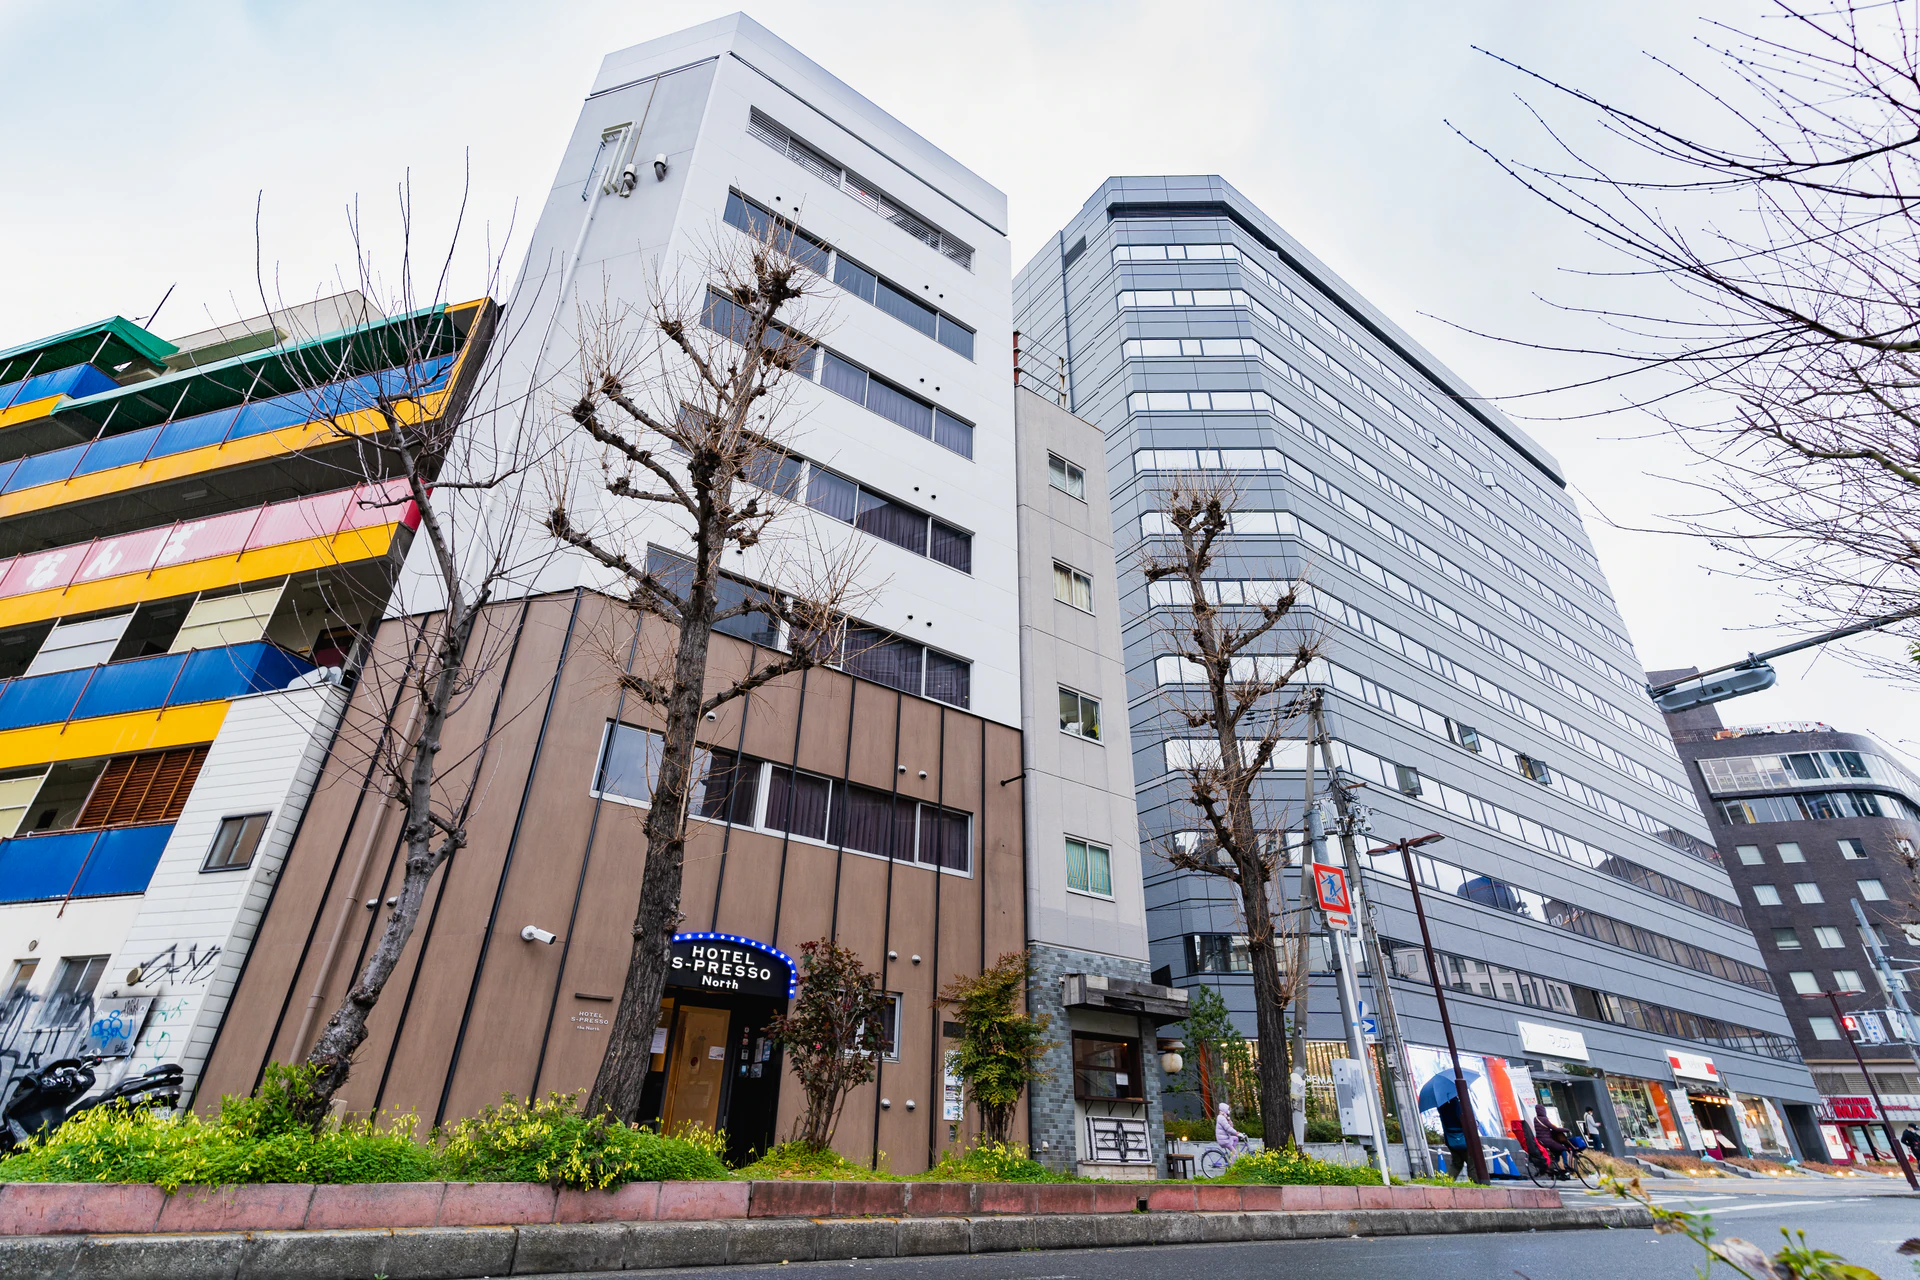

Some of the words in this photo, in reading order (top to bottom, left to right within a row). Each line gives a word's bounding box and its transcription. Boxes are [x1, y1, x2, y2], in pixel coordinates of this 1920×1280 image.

[0, 521, 206, 588] なんば
[692, 946, 755, 965] HOTEL
[671, 956, 771, 980] S-PRESSO
[701, 975, 739, 990] North
[571, 1016, 609, 1024] S-PRESSO
[1833, 1105, 1878, 1119] MAX
